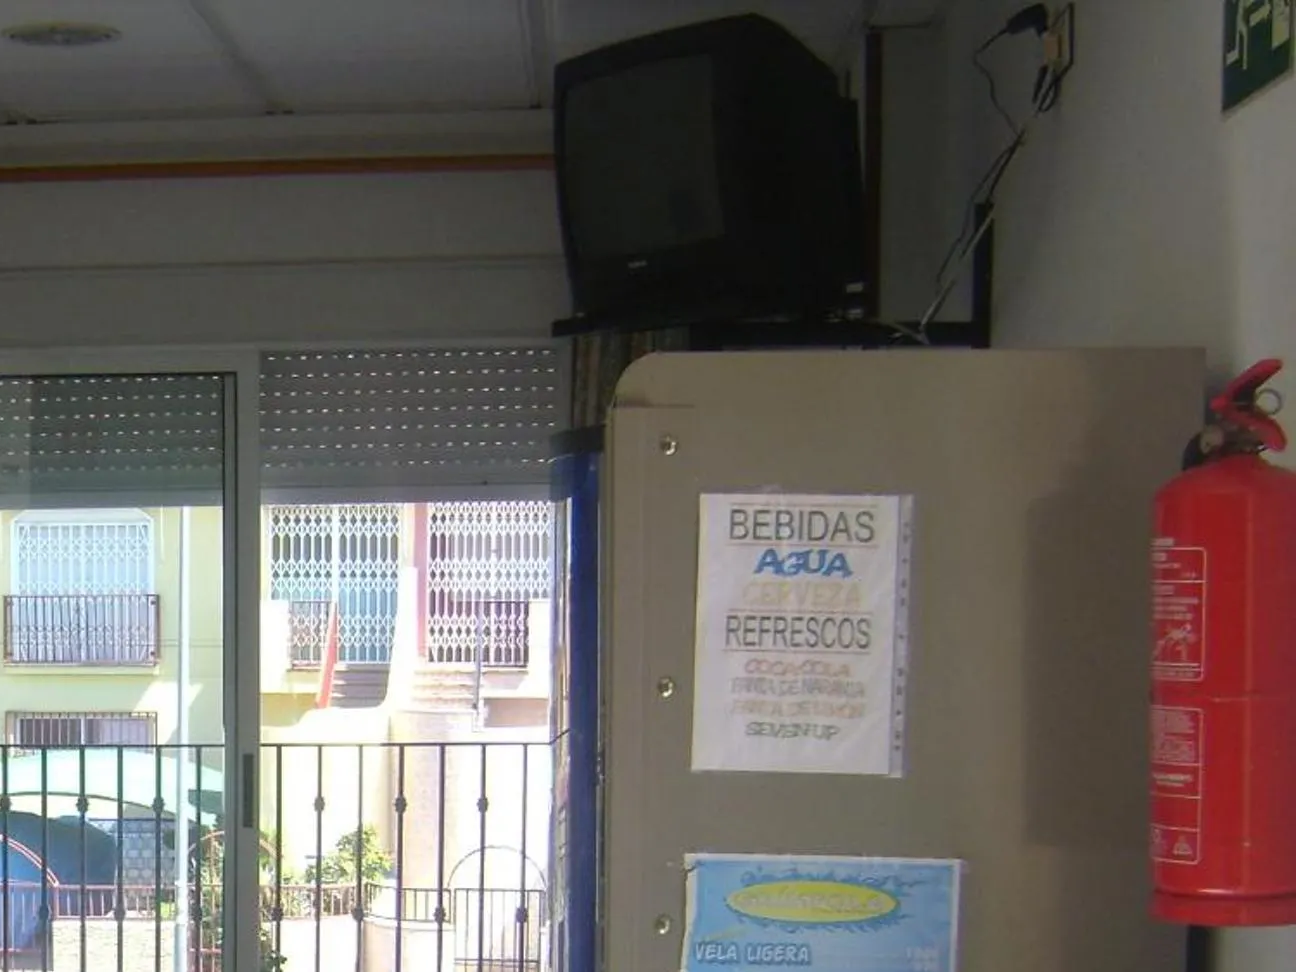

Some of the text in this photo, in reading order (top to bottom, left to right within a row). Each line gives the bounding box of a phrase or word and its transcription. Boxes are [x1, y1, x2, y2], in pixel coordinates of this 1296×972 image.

[729, 508, 875, 543] BEBIDAS
[753, 548, 853, 578] AGUA
[725, 615, 872, 649] REFRESCOS
[694, 943, 810, 962] VELA LIGERA
